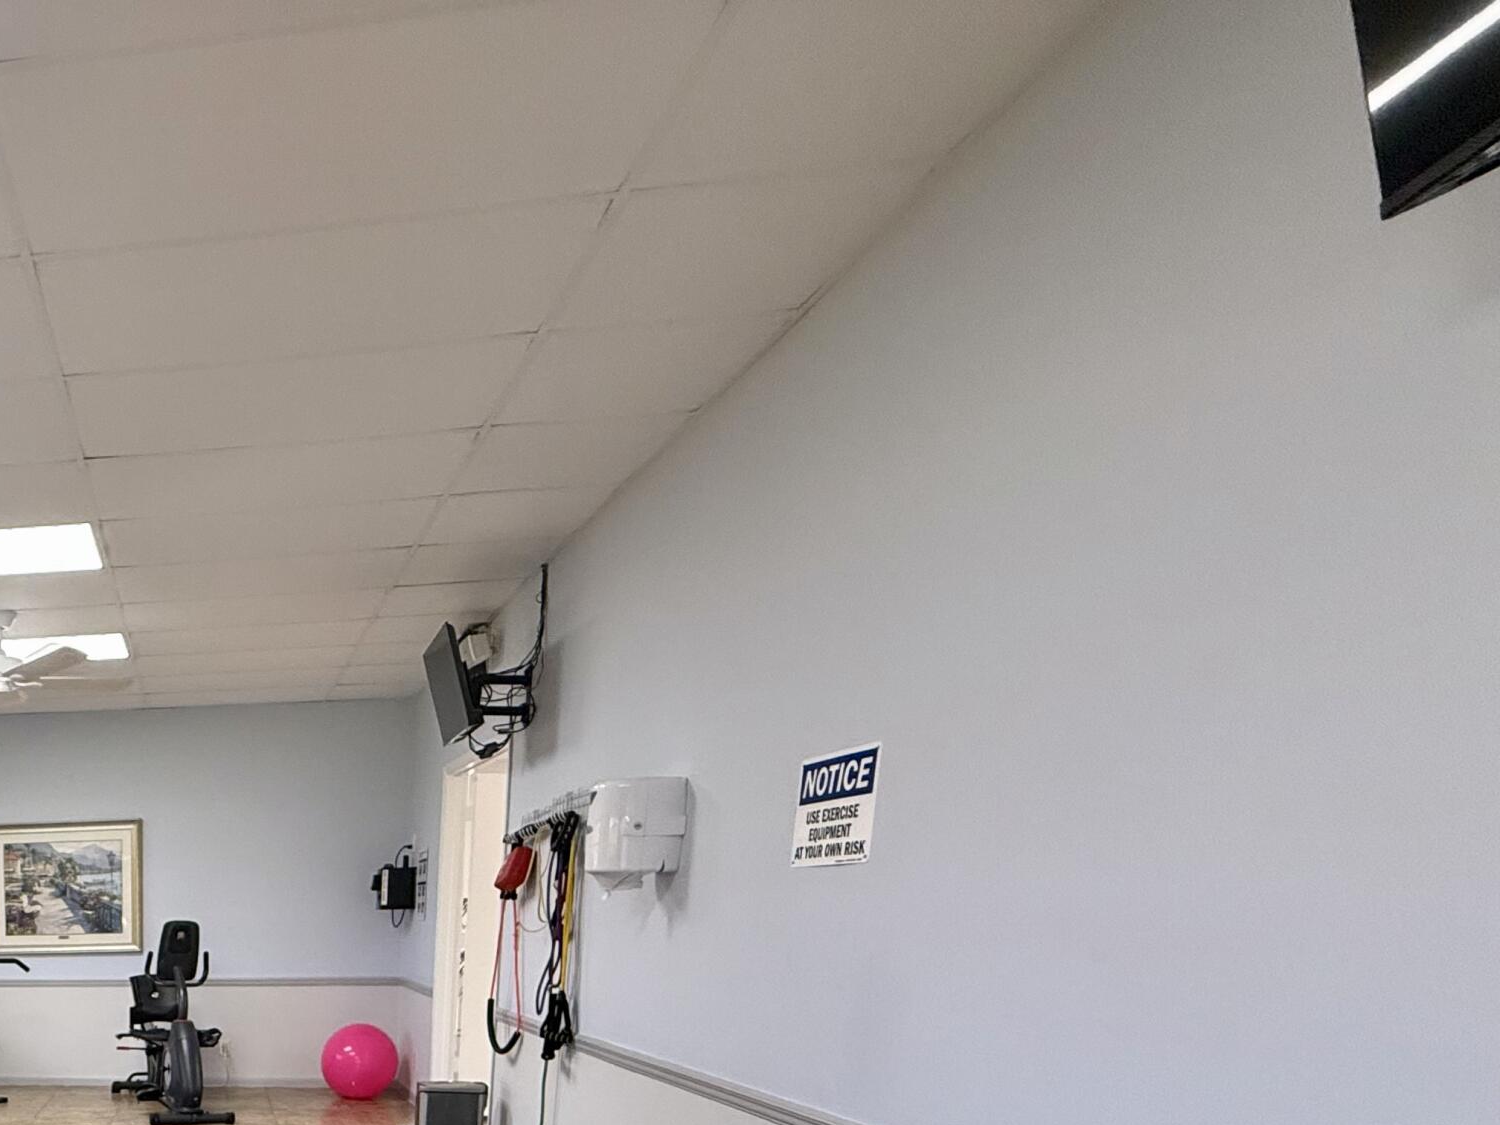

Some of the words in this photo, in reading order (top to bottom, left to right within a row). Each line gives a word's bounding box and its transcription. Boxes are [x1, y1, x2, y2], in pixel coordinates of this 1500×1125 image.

[802, 756, 874, 799] NOTICE
[806, 809, 821, 825] USE
[821, 803, 860, 823] EXERCISE
[808, 823, 852, 843] EQUIPMENT
[794, 846, 805, 860] AT
[804, 844, 823, 860] YOUR
[824, 842, 842, 857] OWN
[844, 839, 866, 856] RISK
